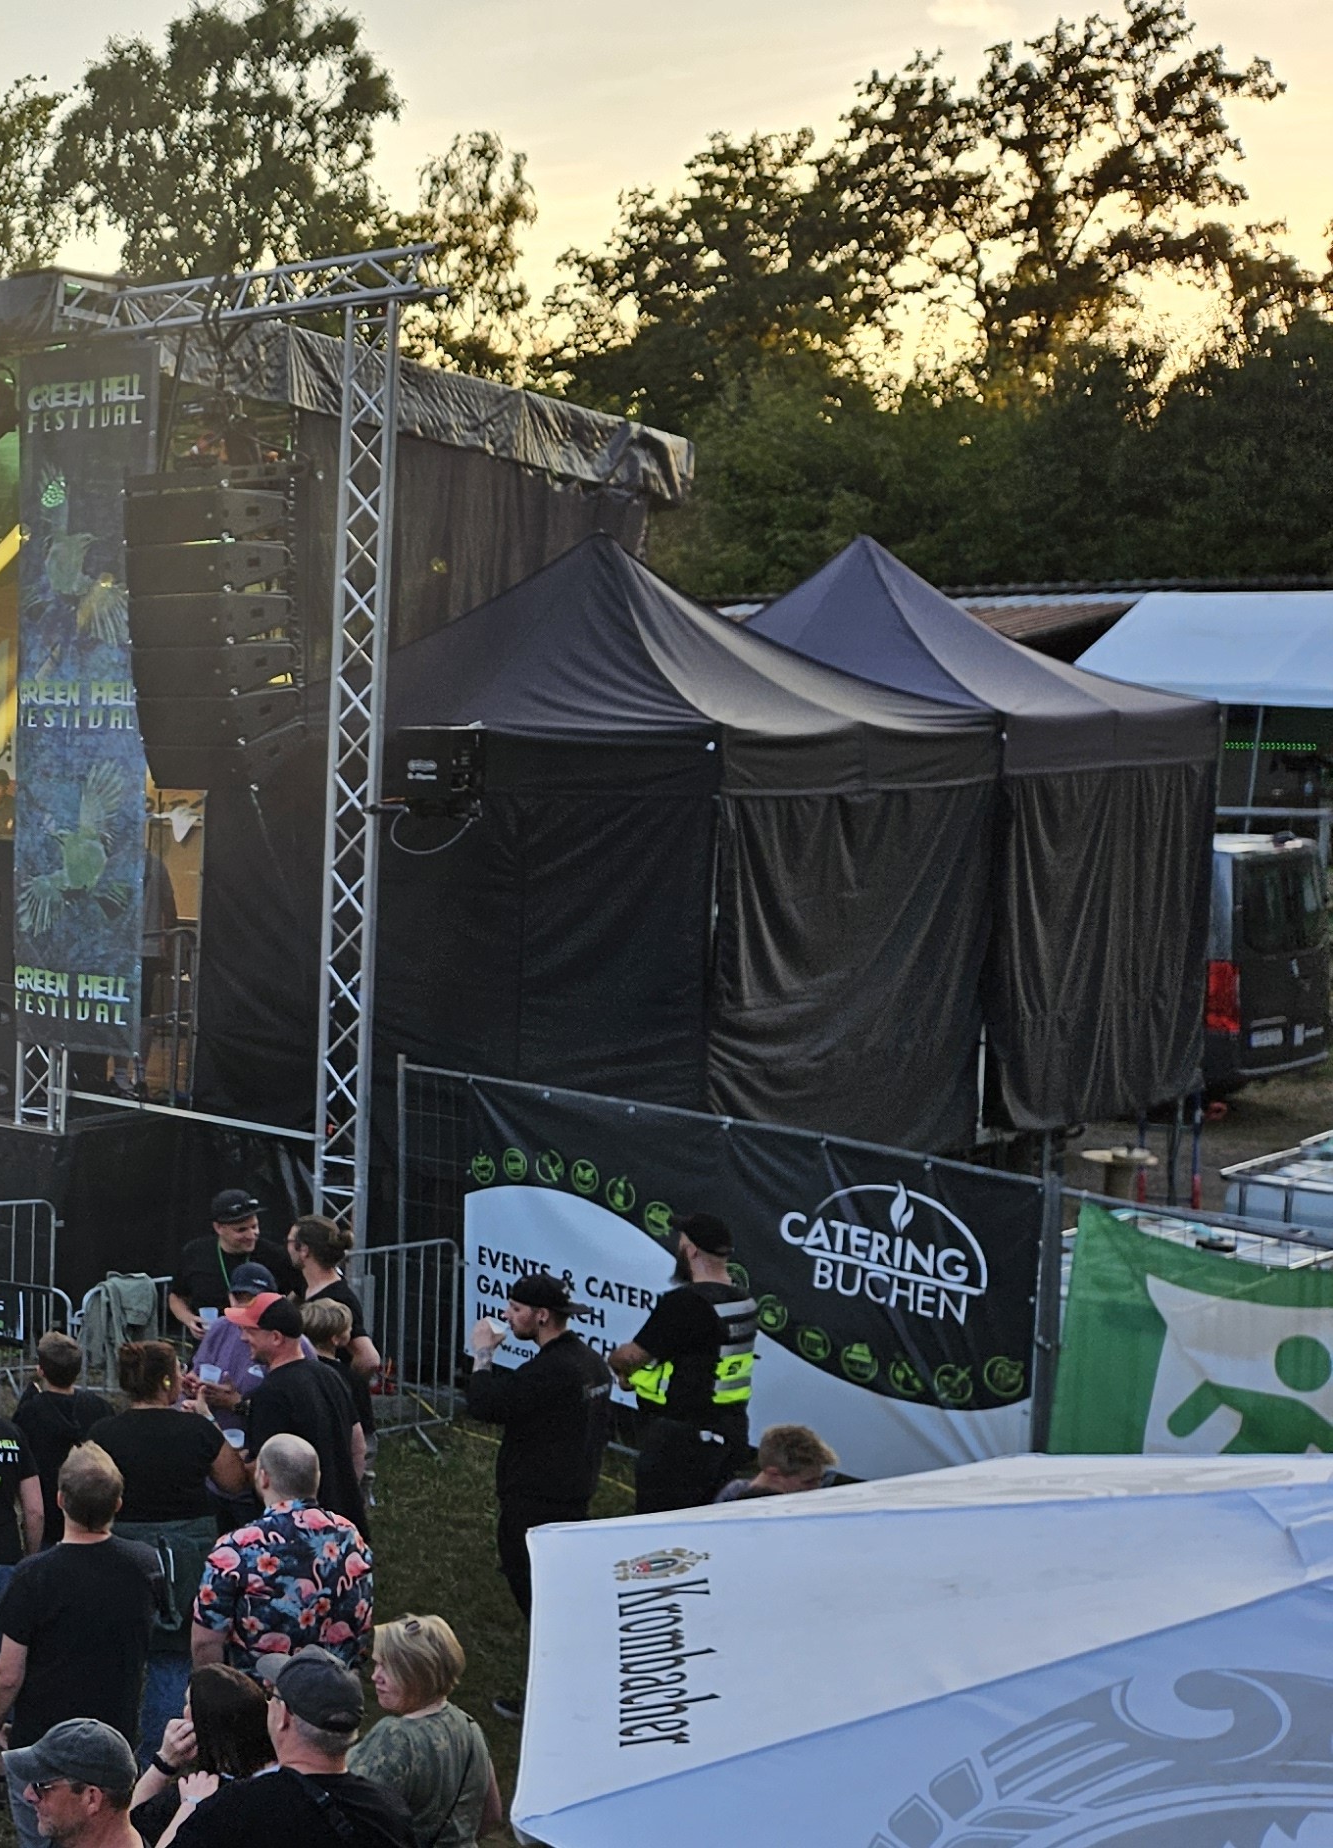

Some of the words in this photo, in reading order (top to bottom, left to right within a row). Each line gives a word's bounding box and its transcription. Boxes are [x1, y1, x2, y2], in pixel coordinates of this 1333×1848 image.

[27, 380, 95, 411] GREEN
[101, 373, 146, 403] HELL
[27, 403, 143, 434] FESTIVAL
[18, 680, 80, 706] GREEN
[91, 680, 137, 706] HELL
[14, 965, 69, 998] GREEN
[77, 973, 131, 1003] HELL
[14, 990, 128, 1026] FESTIVAL
[779, 1211, 969, 1284] CATERING
[561, 1268, 576, 1292] &
[585, 1276, 660, 1312] CATER
[813, 1258, 968, 1326] BUCHEN
[617, 1577, 722, 1748] Krombacher
